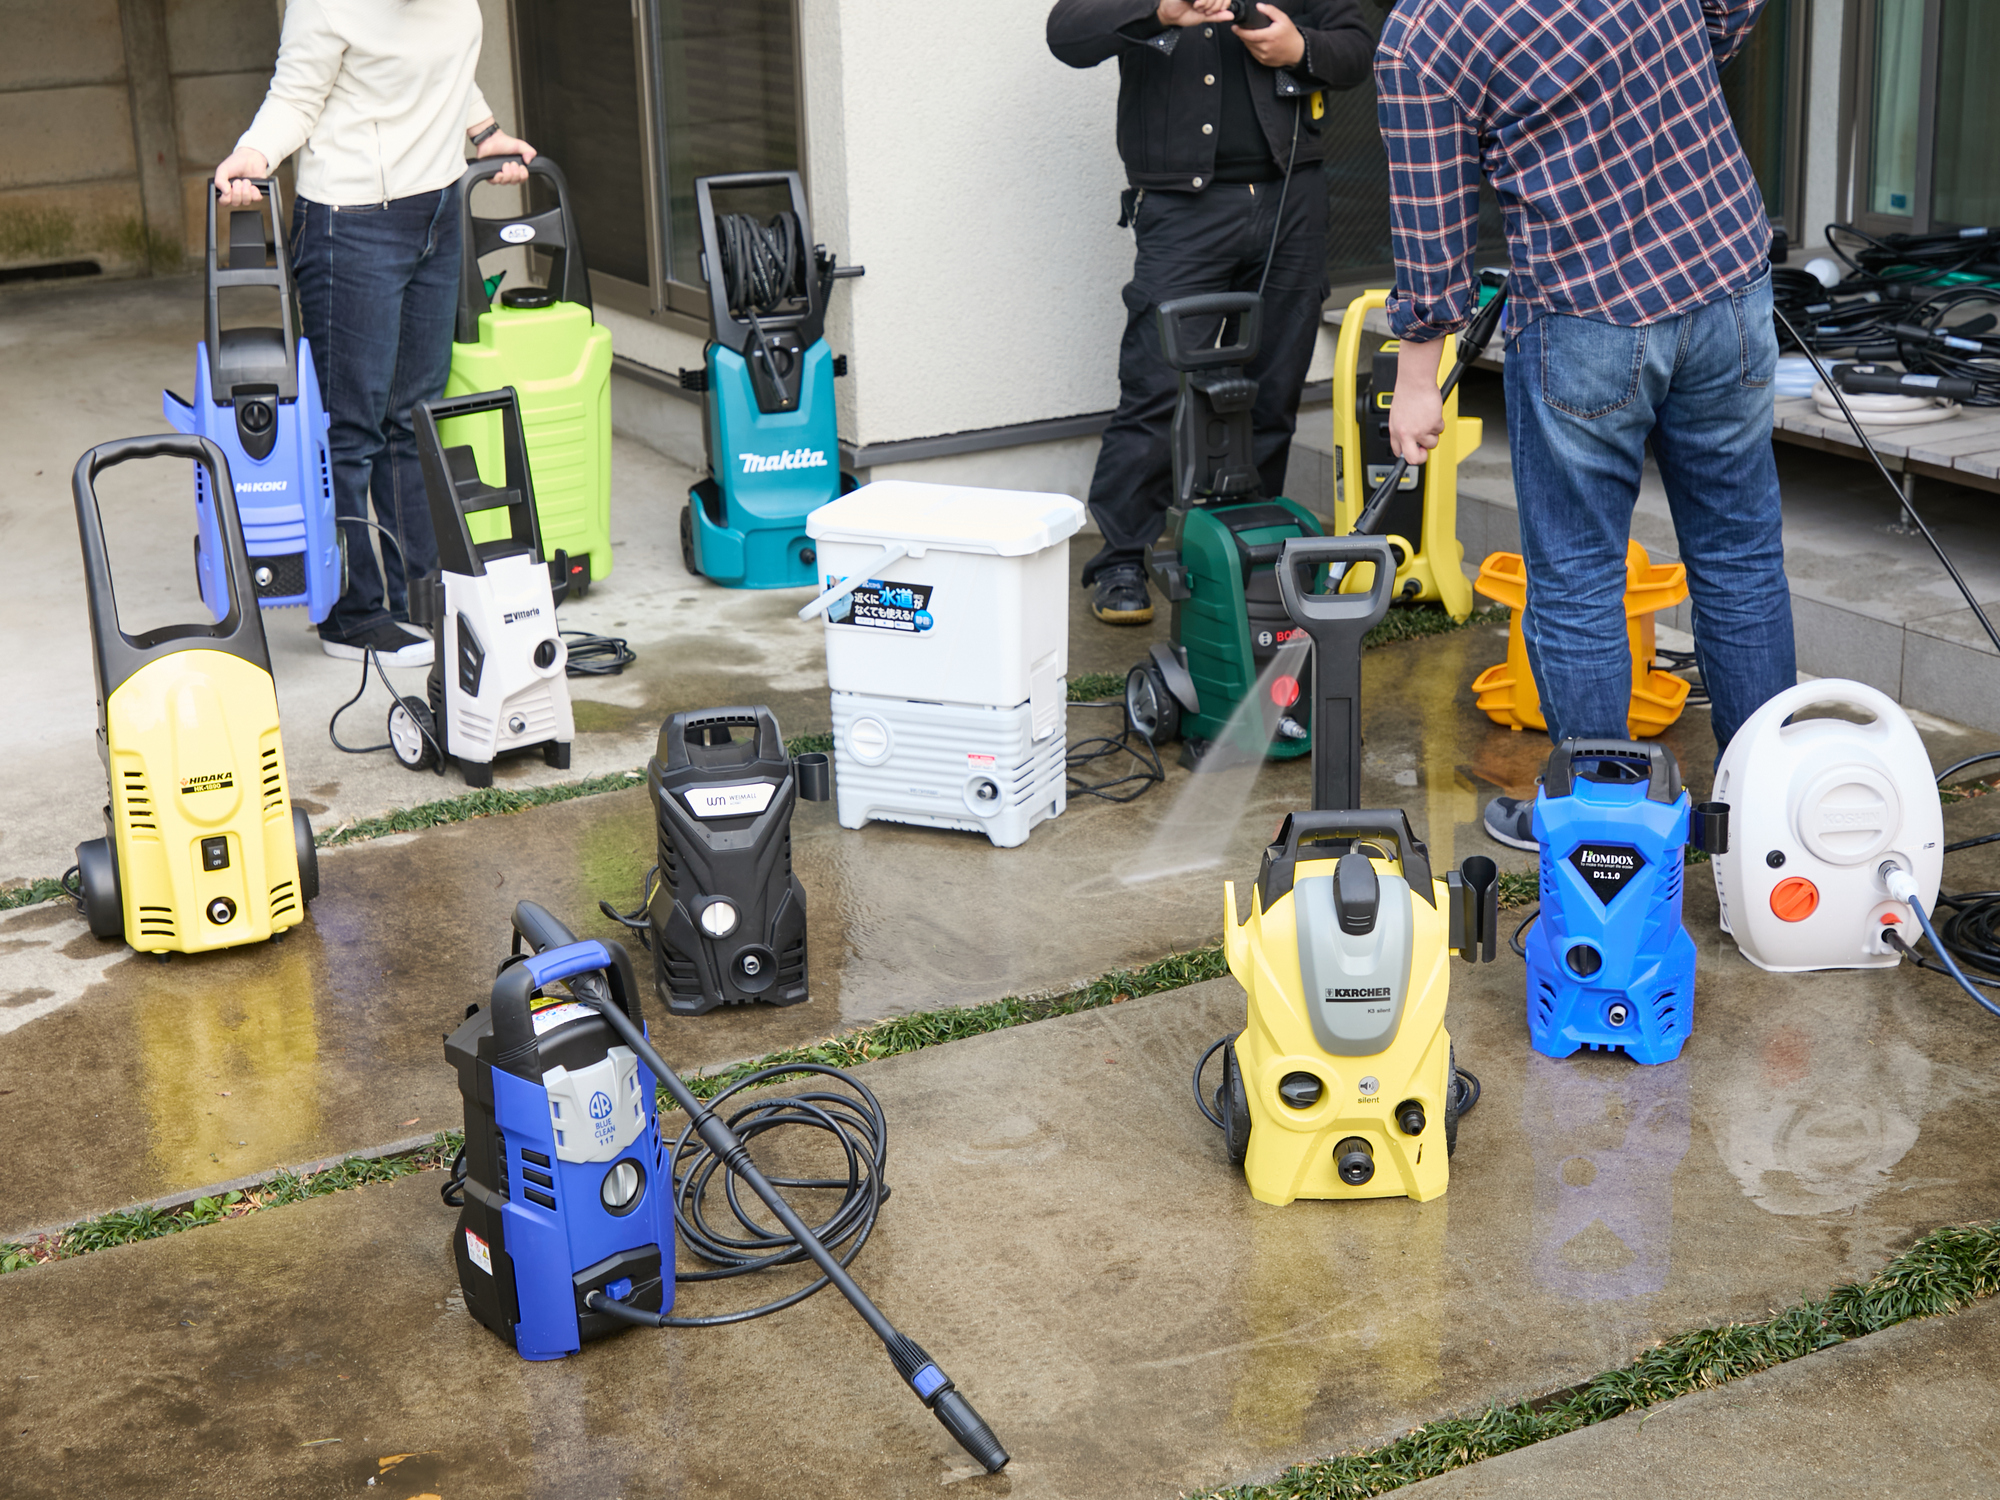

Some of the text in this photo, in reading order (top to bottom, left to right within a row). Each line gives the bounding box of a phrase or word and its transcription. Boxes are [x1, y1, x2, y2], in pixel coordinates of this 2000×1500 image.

[189, 772, 232, 784] HIDAKA
[1823, 812, 1880, 827] KOSHIN
[1581, 850, 1634, 866] HOMDOX
[1593, 871, 1621, 880] D1.1.0
[1334, 987, 1391, 997] KÄRCHER
[590, 1092, 612, 1118] AR
[595, 1118, 612, 1130] BLUE
[594, 1124, 616, 1138] CLEAN
